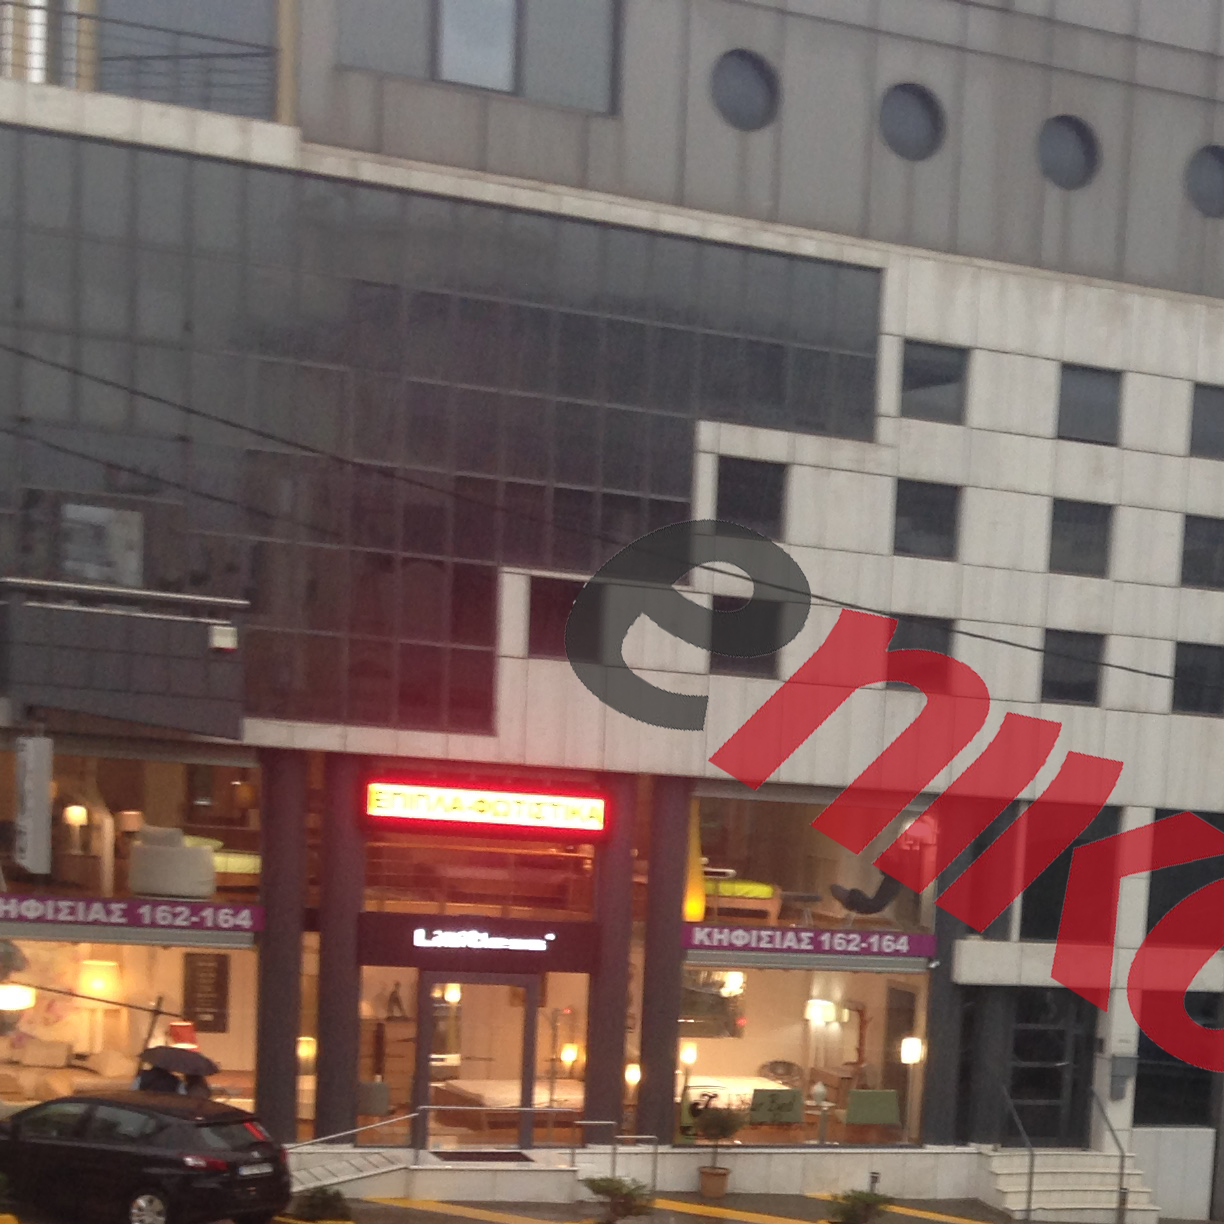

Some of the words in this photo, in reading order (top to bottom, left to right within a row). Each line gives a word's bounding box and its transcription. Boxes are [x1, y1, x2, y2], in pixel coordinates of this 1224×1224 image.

[137, 904, 253, 929] 162-164
[692, 926, 815, 951] ΚΗΦΙΣΙΑΣ
[819, 931, 910, 954] 162-164
